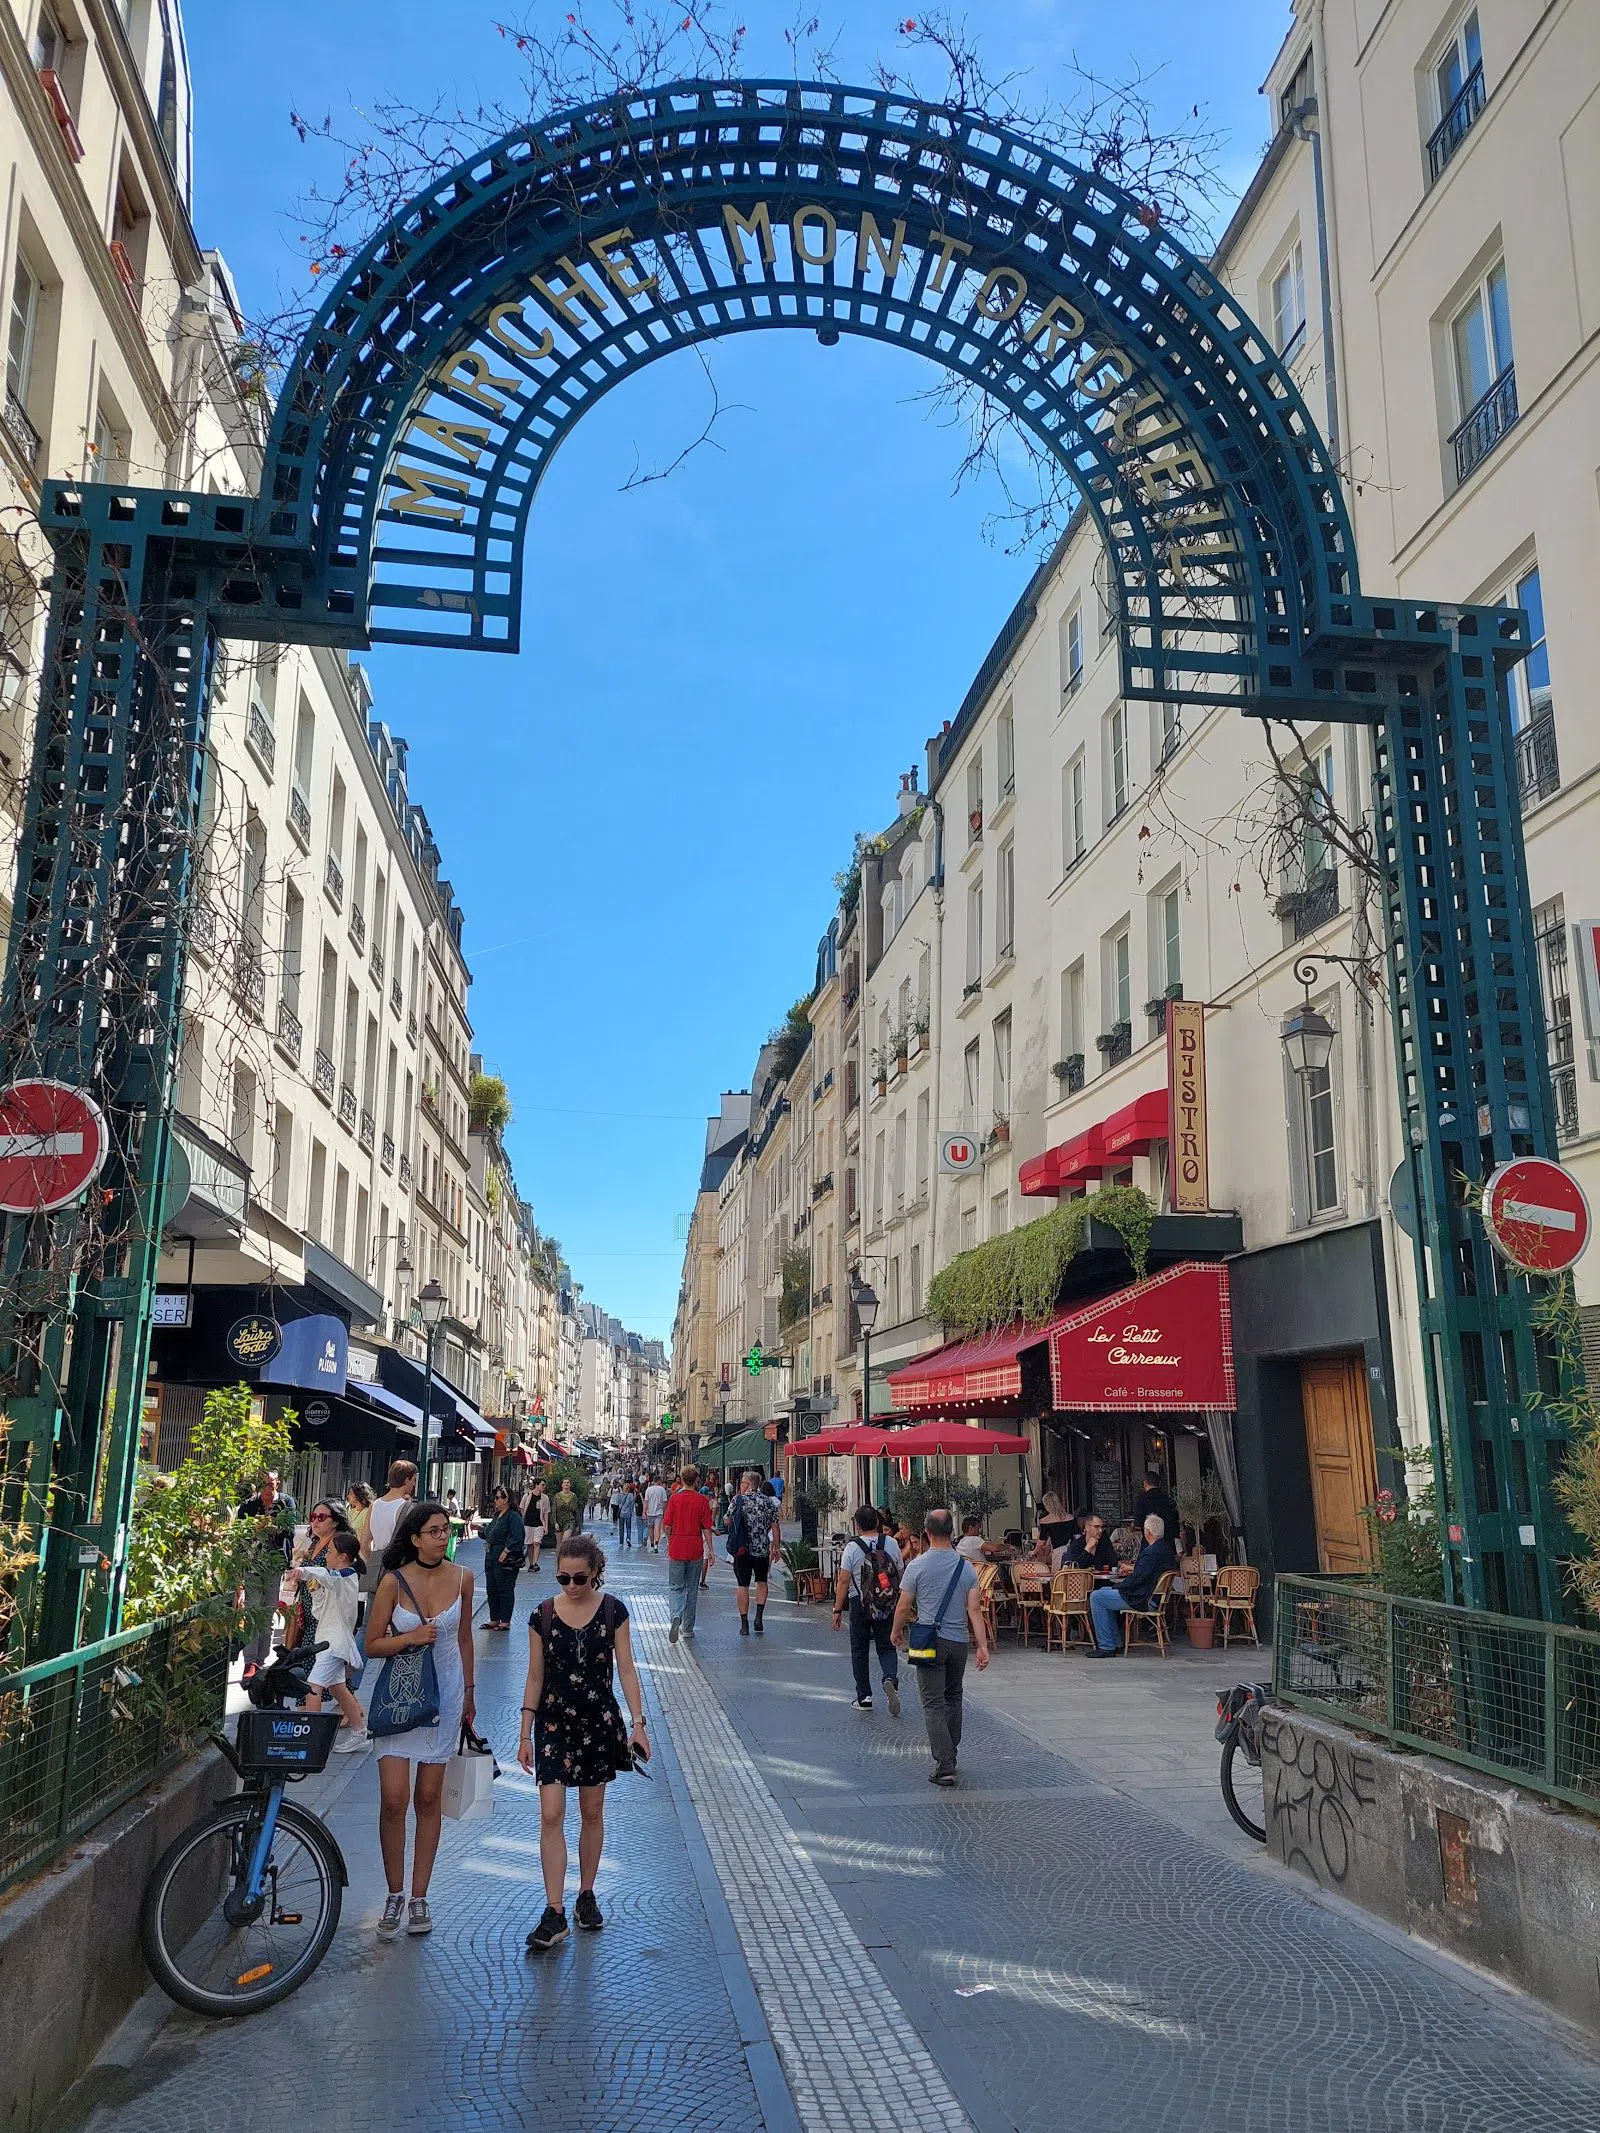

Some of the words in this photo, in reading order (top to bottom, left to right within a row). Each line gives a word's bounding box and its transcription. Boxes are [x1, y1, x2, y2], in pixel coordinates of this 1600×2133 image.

[389, 227, 660, 527] MARCHE
[722, 201, 1238, 585] MONTORGUEIL
[1178, 1028, 1201, 1184] BISTRO
[950, 1145, 968, 1162] U
[233, 1328, 274, 1345] Laura
[1087, 1325, 1116, 1343] Les
[1122, 1324, 1163, 1343] Petits
[1107, 1346, 1182, 1367] Carreaux
[1104, 1387, 1128, 1398] Café
[1137, 1387, 1184, 1398] Brasserie
[271, 1720, 311, 1738] Véligo
